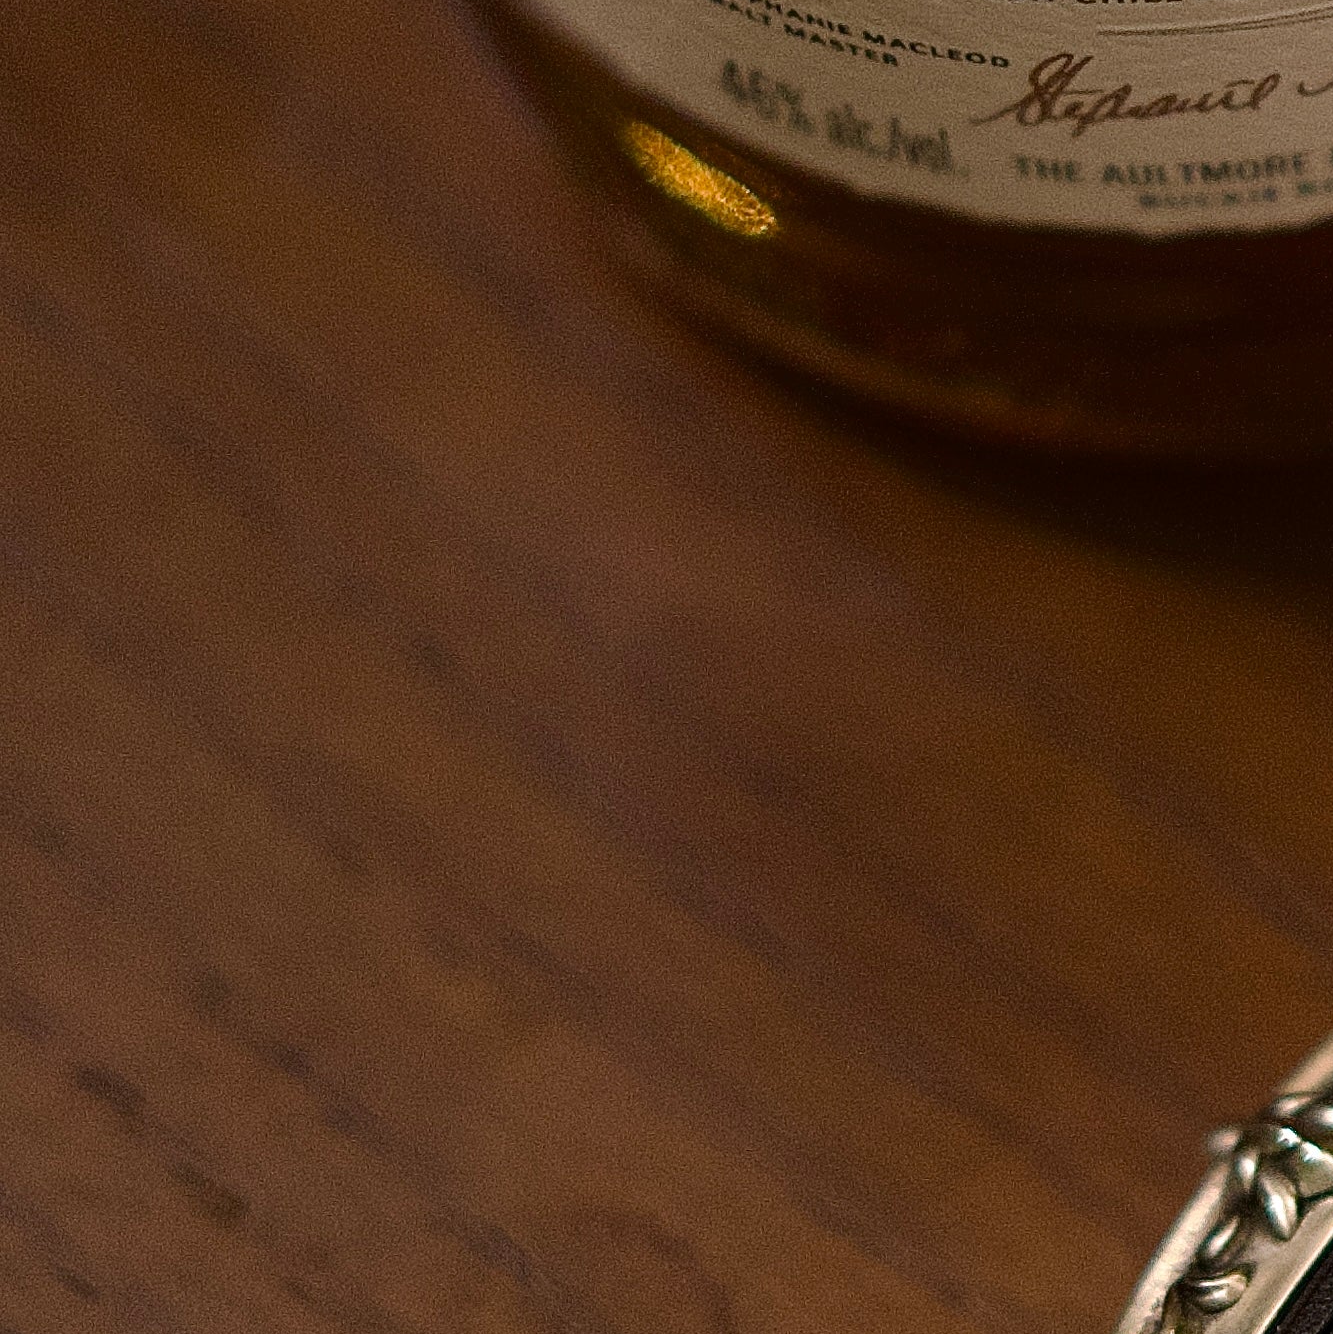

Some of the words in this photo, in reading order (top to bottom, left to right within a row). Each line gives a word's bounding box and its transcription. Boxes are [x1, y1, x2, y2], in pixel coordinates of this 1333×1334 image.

[784, 23, 899, 67] MASTER
[862, 29, 1010, 69] MACLEOD
[1015, 154, 1079, 184] THE
[1101, 151, 1308, 187] AULTMORE
